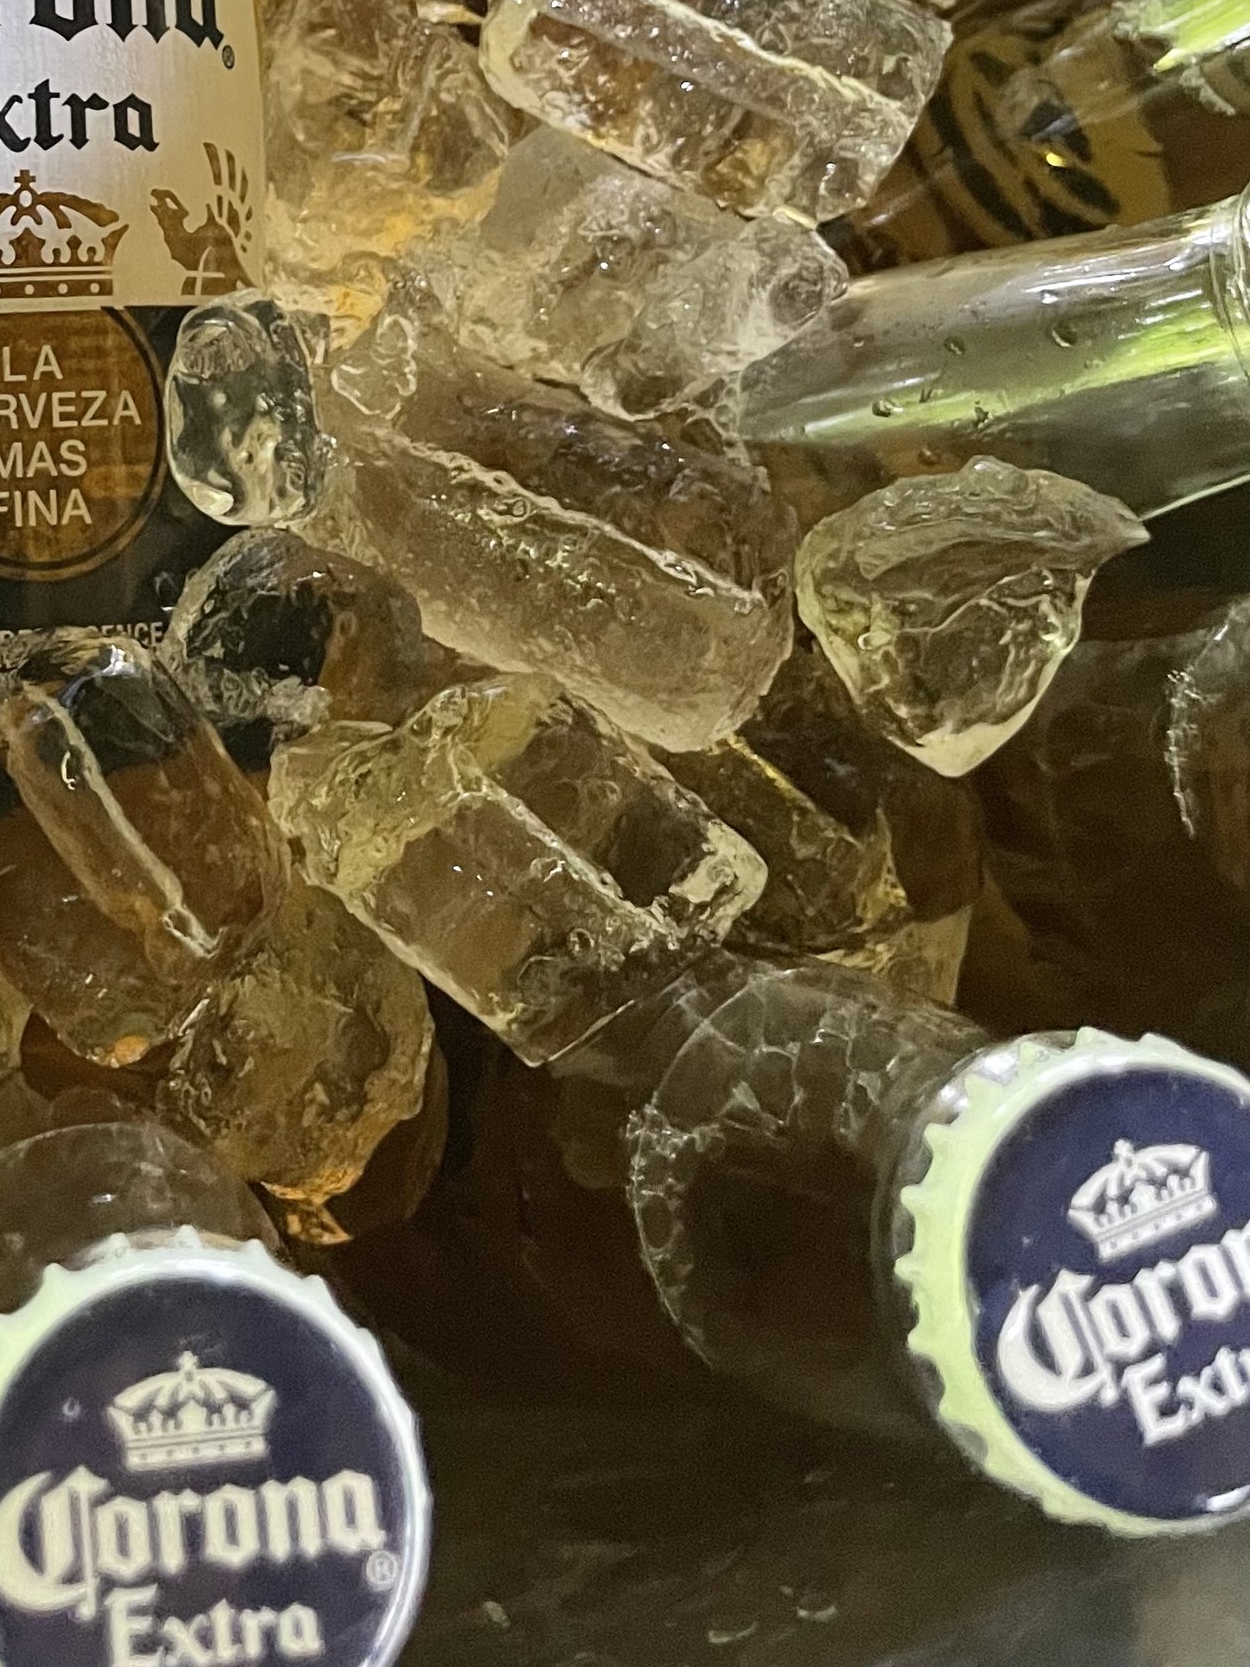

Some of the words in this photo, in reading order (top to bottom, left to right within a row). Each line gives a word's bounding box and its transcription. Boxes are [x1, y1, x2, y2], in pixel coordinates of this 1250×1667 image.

[1, 344, 64, 383] LA
[1123, 1345, 1250, 1447] Ext
[103, 1584, 326, 1667] Extra
